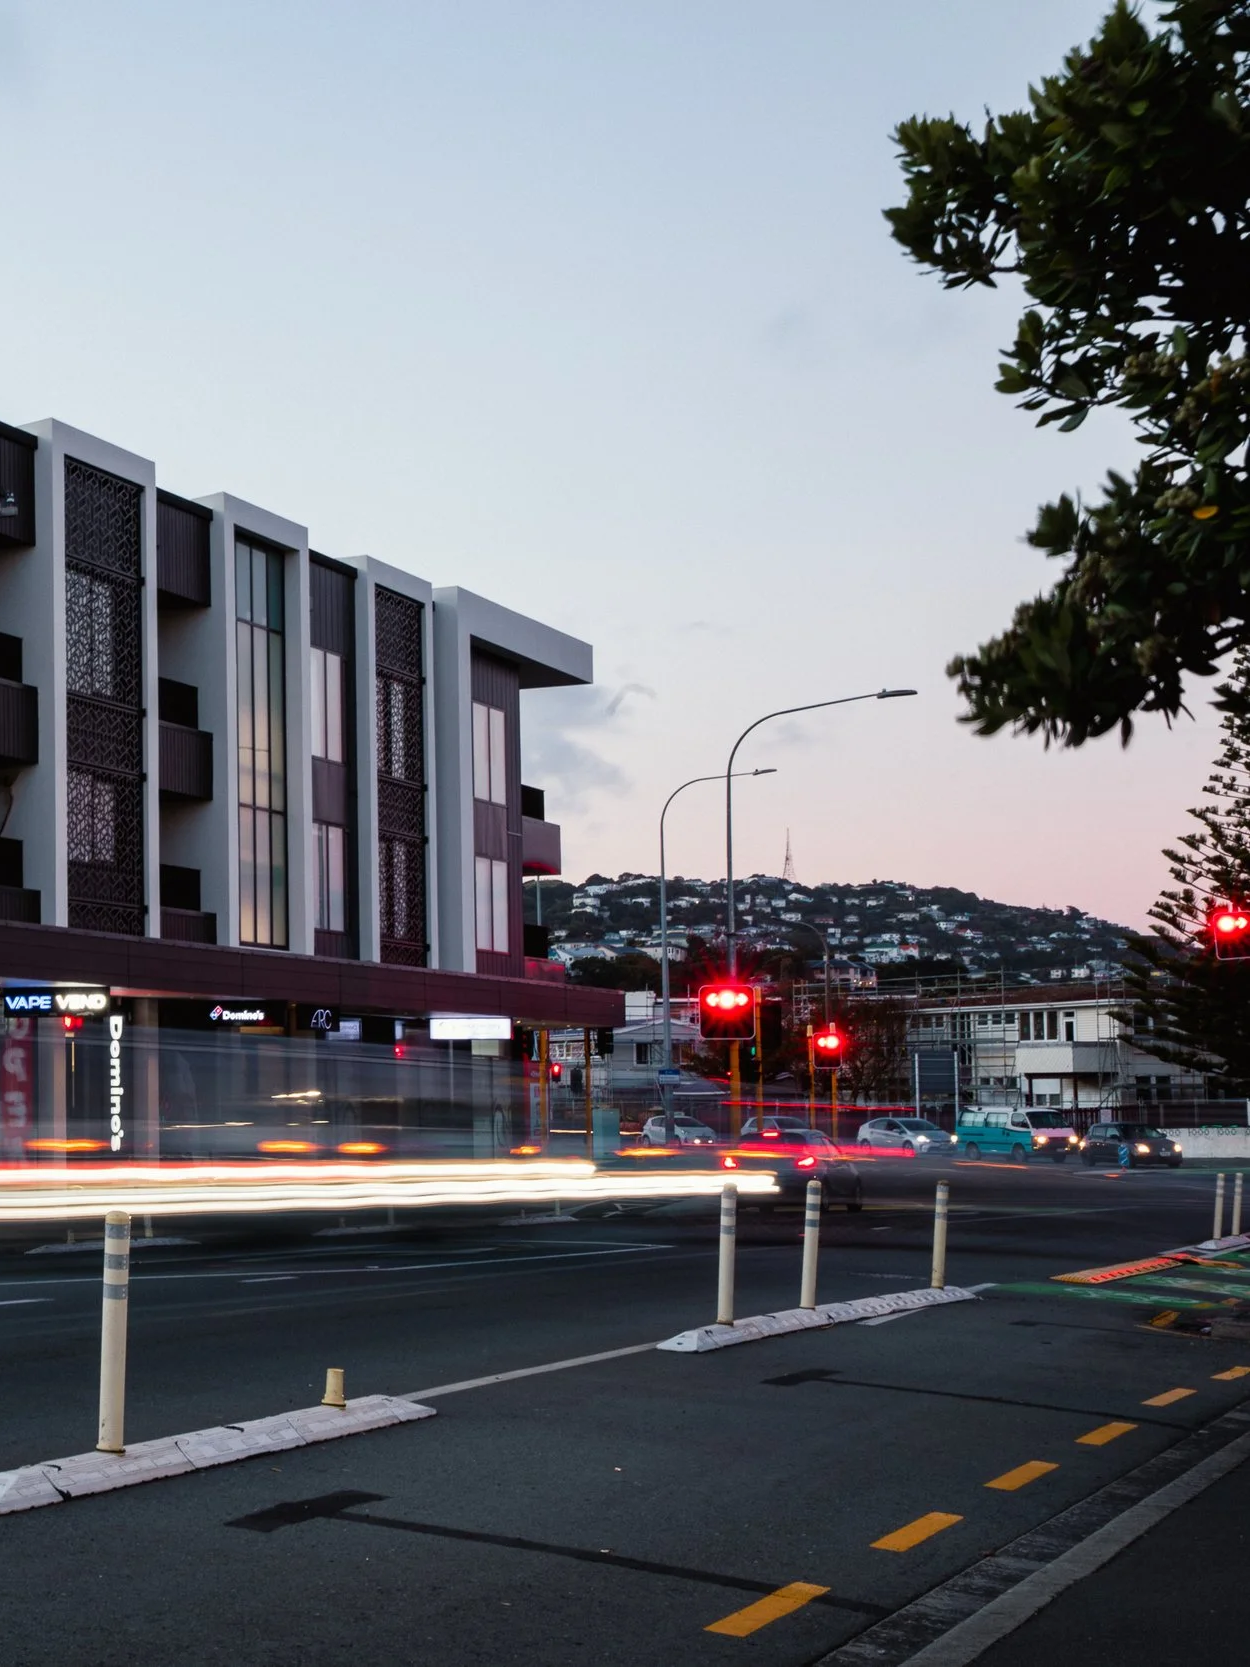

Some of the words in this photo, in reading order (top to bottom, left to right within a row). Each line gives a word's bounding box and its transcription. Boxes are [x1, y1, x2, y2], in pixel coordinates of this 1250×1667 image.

[5, 996, 51, 1010] VAPE
[55, 994, 107, 1010] VEND
[222, 1010, 265, 1021] Domino's
[310, 1009, 332, 1029] ARC
[110, 1015, 124, 1152] Domino's
